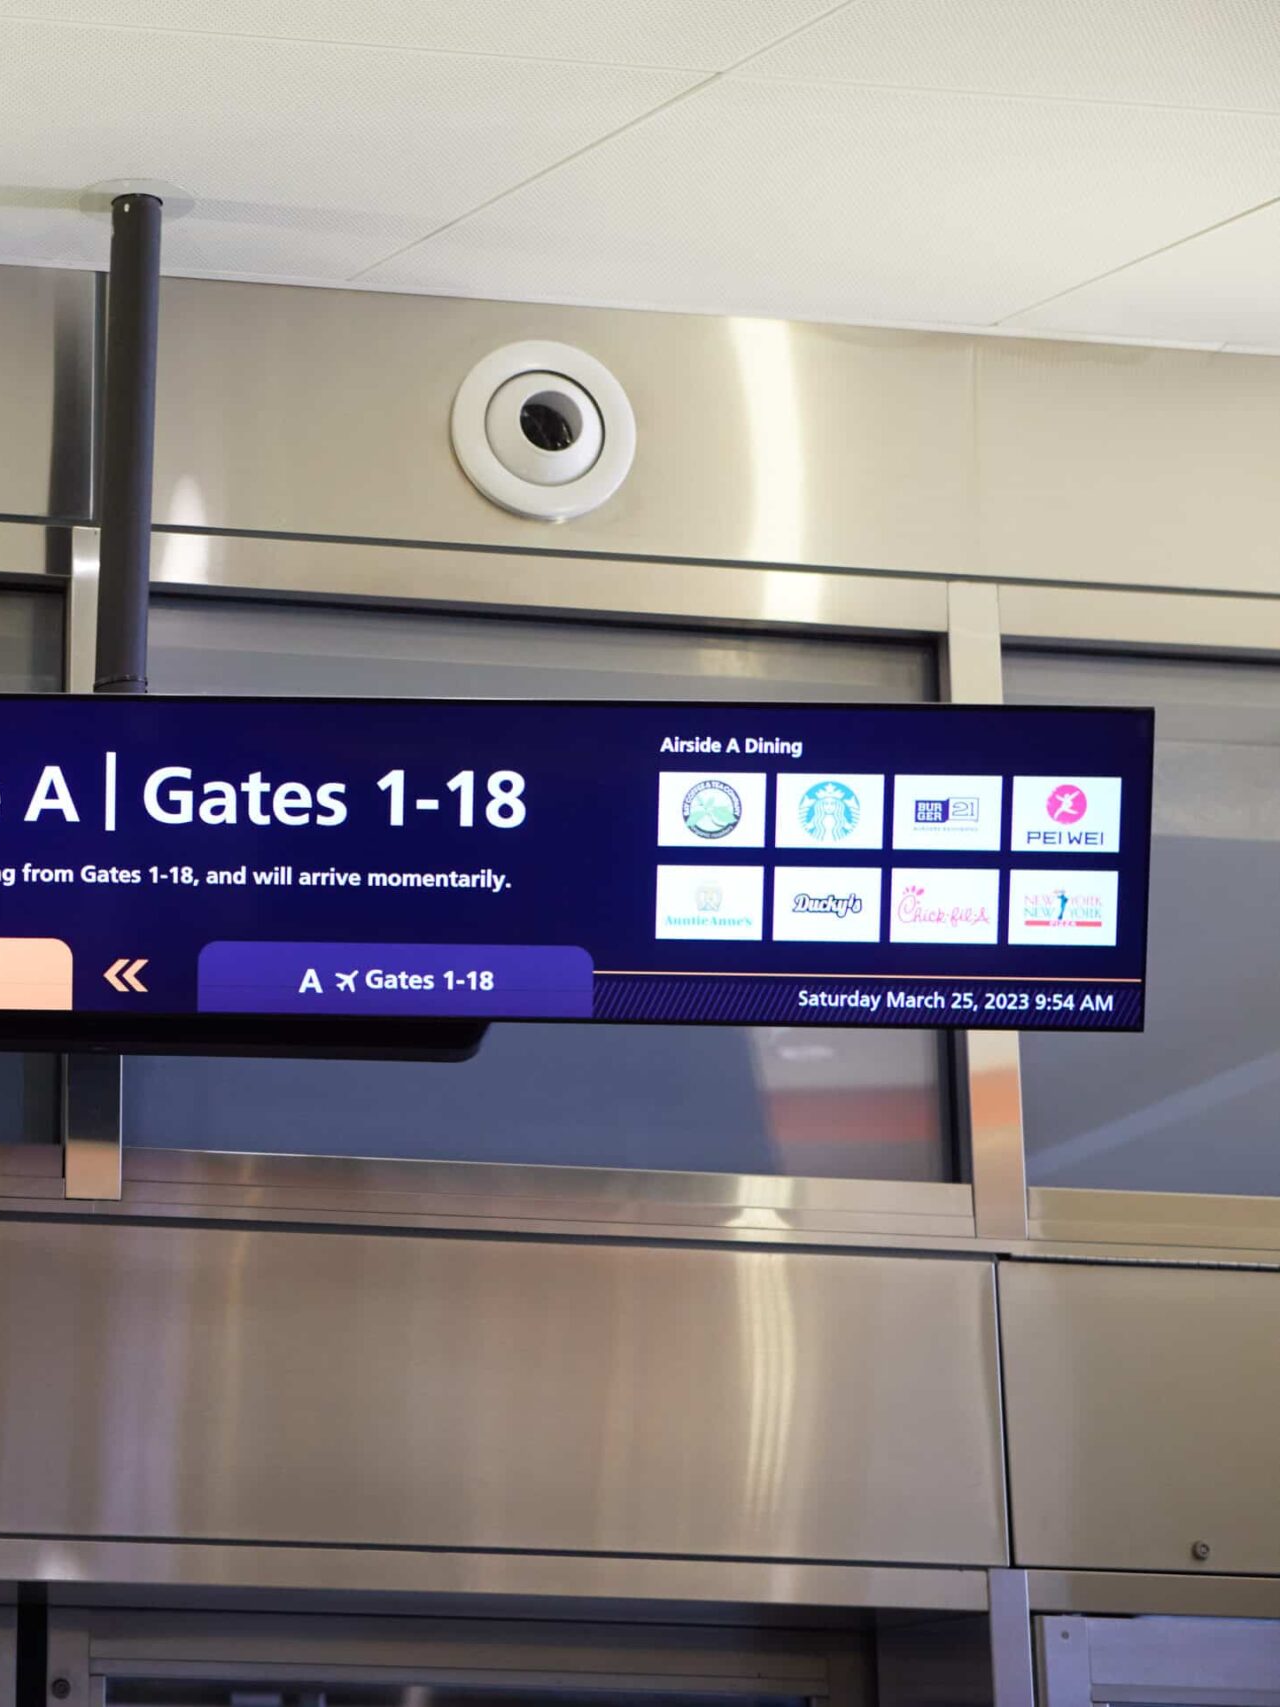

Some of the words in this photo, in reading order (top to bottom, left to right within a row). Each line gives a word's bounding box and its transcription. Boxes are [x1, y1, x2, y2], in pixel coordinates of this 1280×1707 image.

[659, 736, 722, 753] Airside
[725, 737, 741, 754] A
[745, 736, 803, 758] Dining
[23, 765, 81, 823] A
[143, 766, 348, 826] Gates
[376, 769, 527, 829] 1-18
[917, 802, 942, 812] BUR
[916, 811, 942, 821] GER
[951, 801, 975, 817] 21
[1027, 831, 1062, 845] PEI
[1067, 831, 1104, 846] WEI
[21, 862, 74, 883] from
[80, 864, 142, 884] Gates
[148, 866, 200, 887] 1-18,
[205, 865, 247, 885] and
[252, 866, 292, 885] will
[298, 867, 362, 886] arrive
[367, 868, 512, 893] momentarily.
[792, 893, 862, 918] Ducky's
[298, 968, 324, 994] A
[365, 969, 435, 990] Gates
[443, 970, 494, 991] 1-18
[798, 990, 881, 1012] Saturday
[887, 991, 945, 1009] March
[951, 992, 978, 1012] 25,
[984, 993, 1029, 1010] 2023
[1035, 993, 1075, 1011] 9:54
[1080, 994, 1113, 1011] AM
